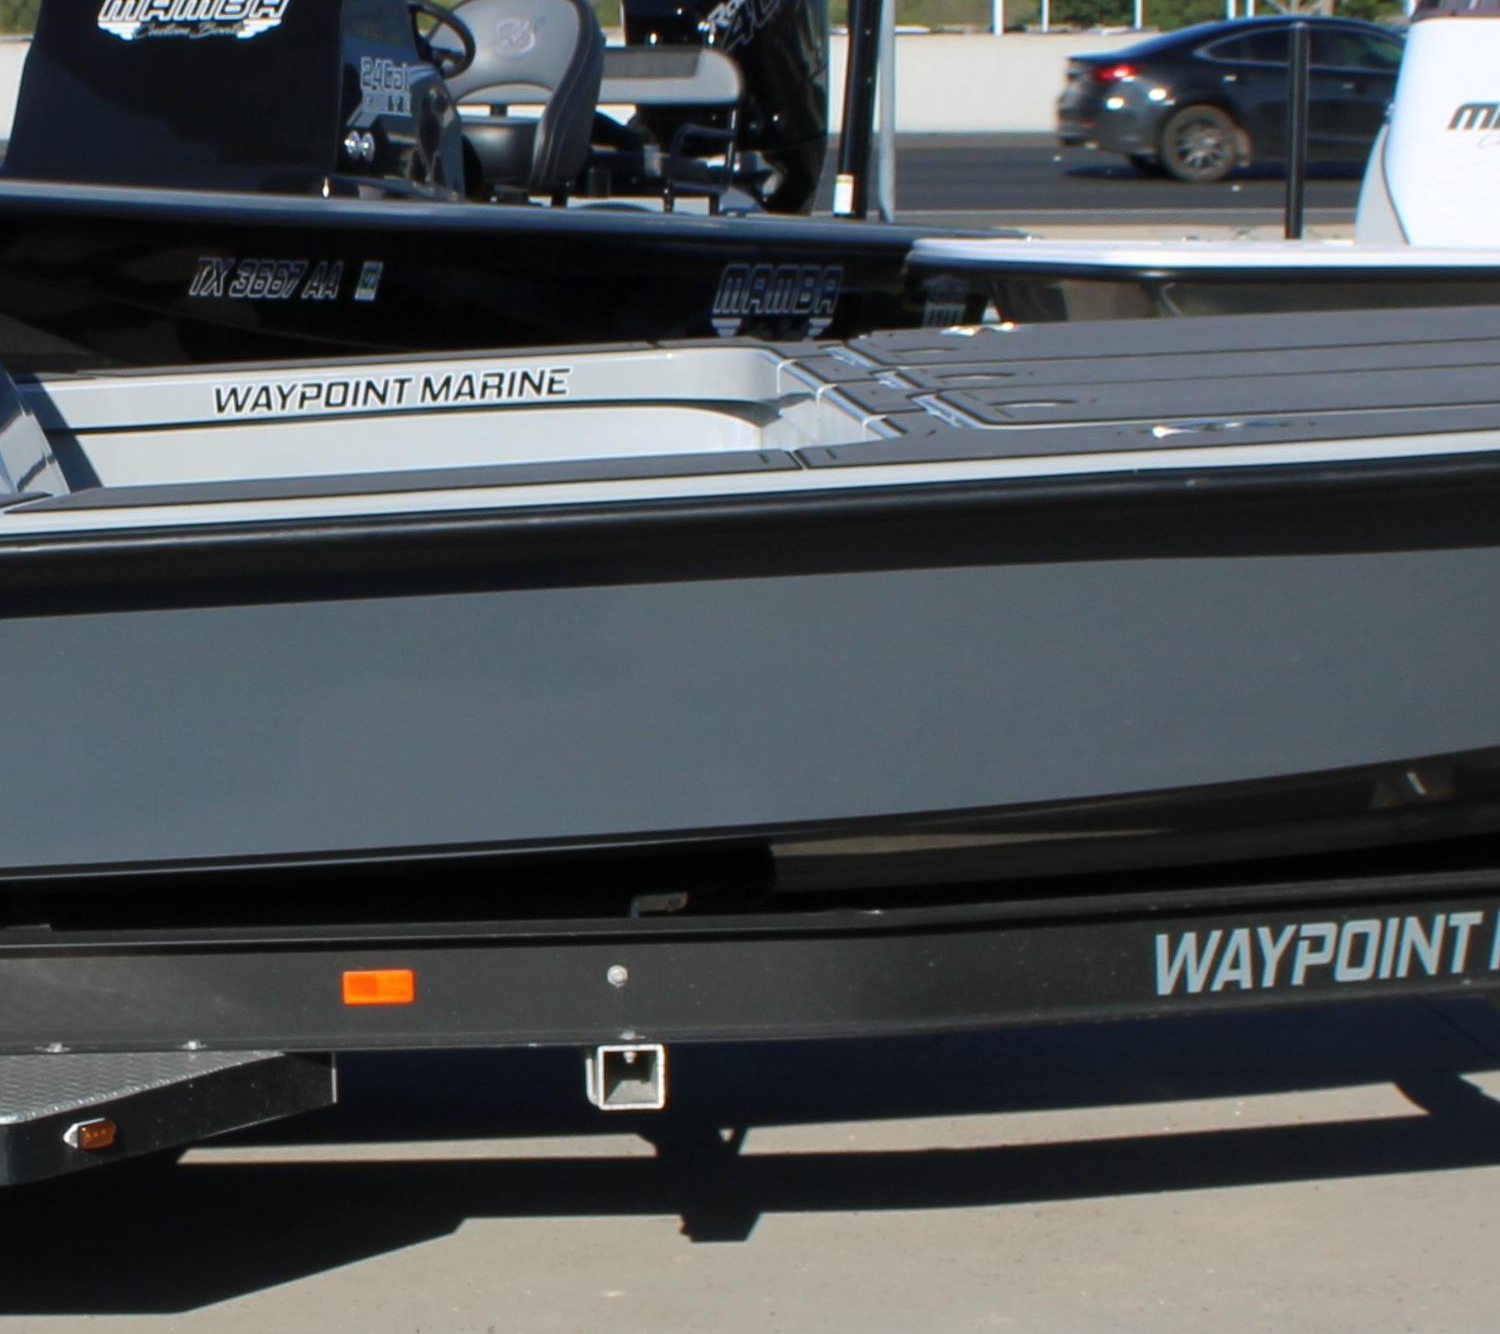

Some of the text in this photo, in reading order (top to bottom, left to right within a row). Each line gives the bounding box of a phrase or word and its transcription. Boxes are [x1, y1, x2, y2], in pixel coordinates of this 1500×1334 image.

[188, 257, 237, 297] TX
[300, 260, 345, 299] AA
[711, 262, 845, 315] MAMBA
[213, 367, 572, 415] WAYPOINT MARINE
[1154, 911, 1484, 997] WAYPOINT
